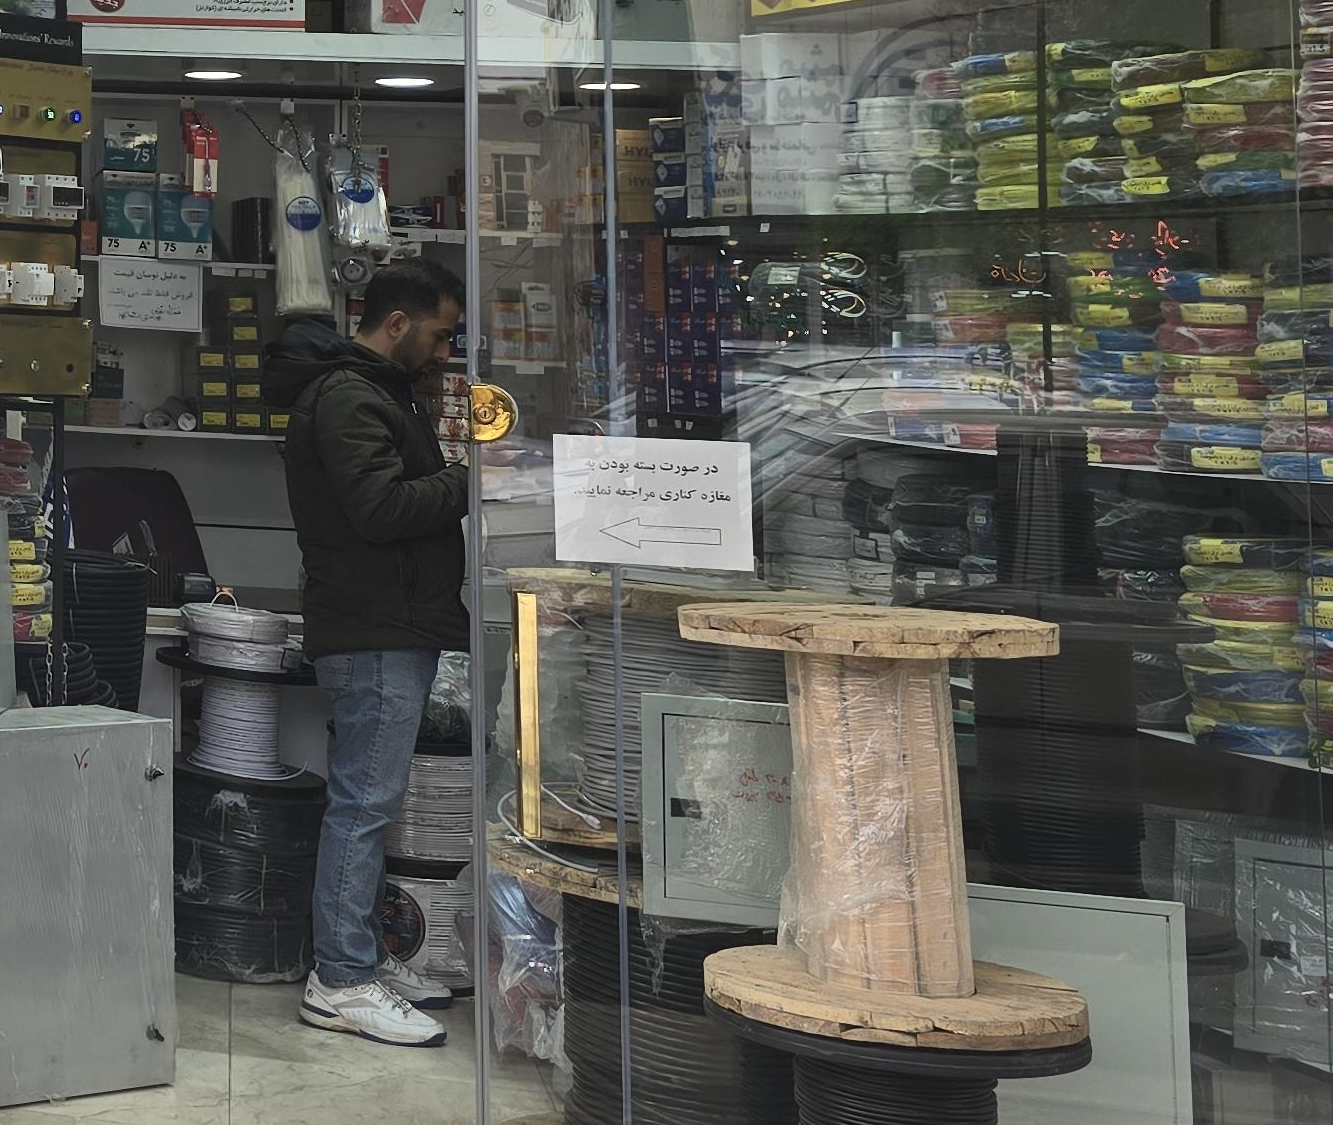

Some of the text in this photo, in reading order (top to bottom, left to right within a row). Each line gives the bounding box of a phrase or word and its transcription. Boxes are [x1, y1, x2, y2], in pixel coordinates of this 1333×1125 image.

[134, 148, 150, 163] 75
[108, 238, 119, 248] 75
[164, 242, 176, 252] 75
[599, 460, 630, 473] بودن
[633, 463, 656, 474] بسته
[660, 462, 699, 476] صورت
[703, 464, 719, 475] در
[615, 487, 656, 501] مراجعه
[659, 489, 697, 501] کناری
[701, 491, 731, 503] مغازه
